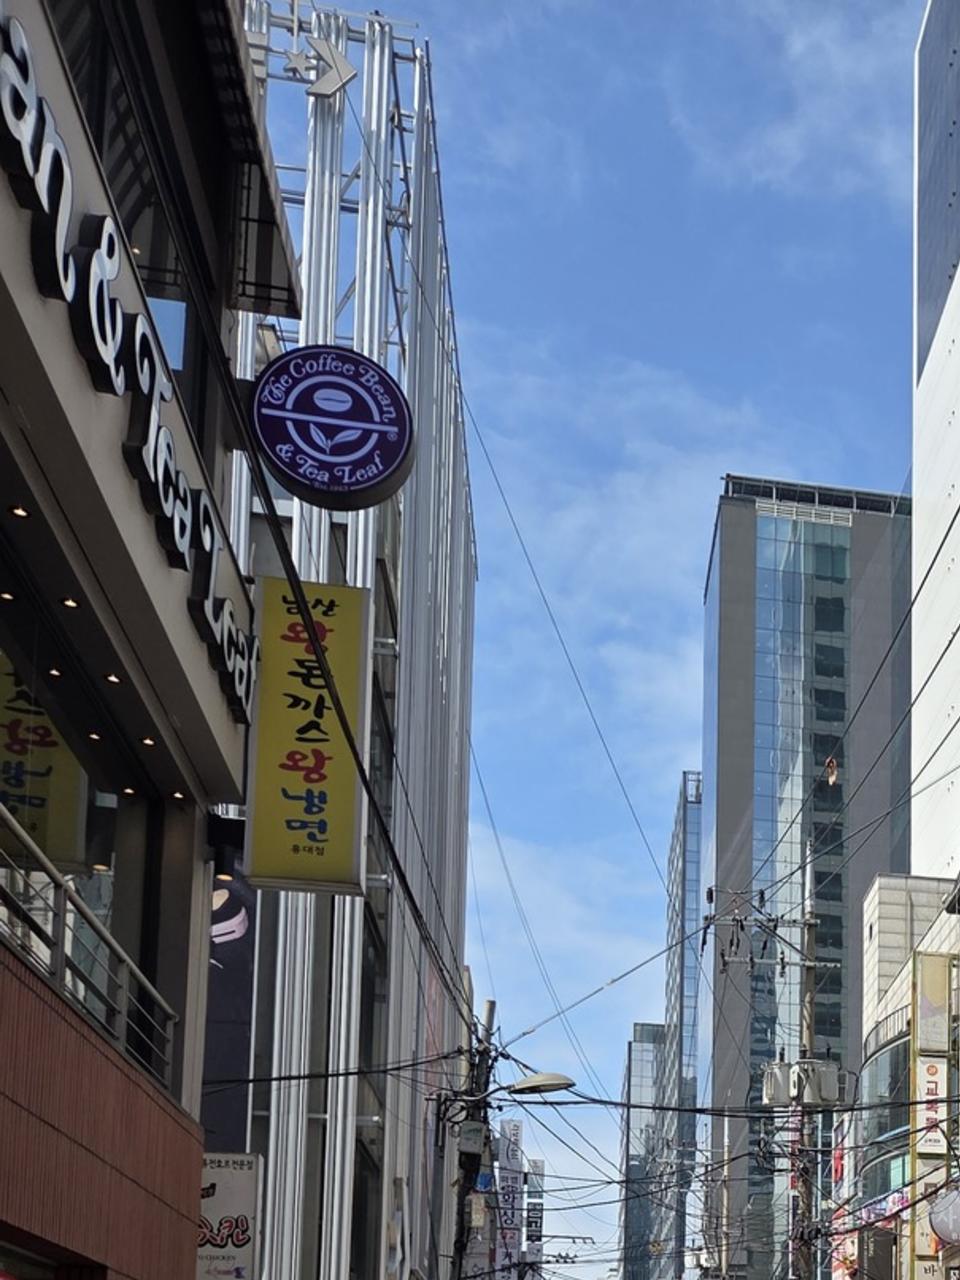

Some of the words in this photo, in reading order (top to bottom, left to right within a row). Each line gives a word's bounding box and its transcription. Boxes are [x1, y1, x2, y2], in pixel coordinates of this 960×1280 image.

[260, 374, 293, 406] The
[289, 353, 355, 379] Coffee
[358, 364, 397, 423] Bean
[87, 215, 125, 396] &
[133, 312, 193, 572] Tea
[196, 488, 262, 727] Leaf
[275, 443, 295, 463] &
[296, 454, 330, 483] Tea
[333, 450, 385, 484] Leaf
